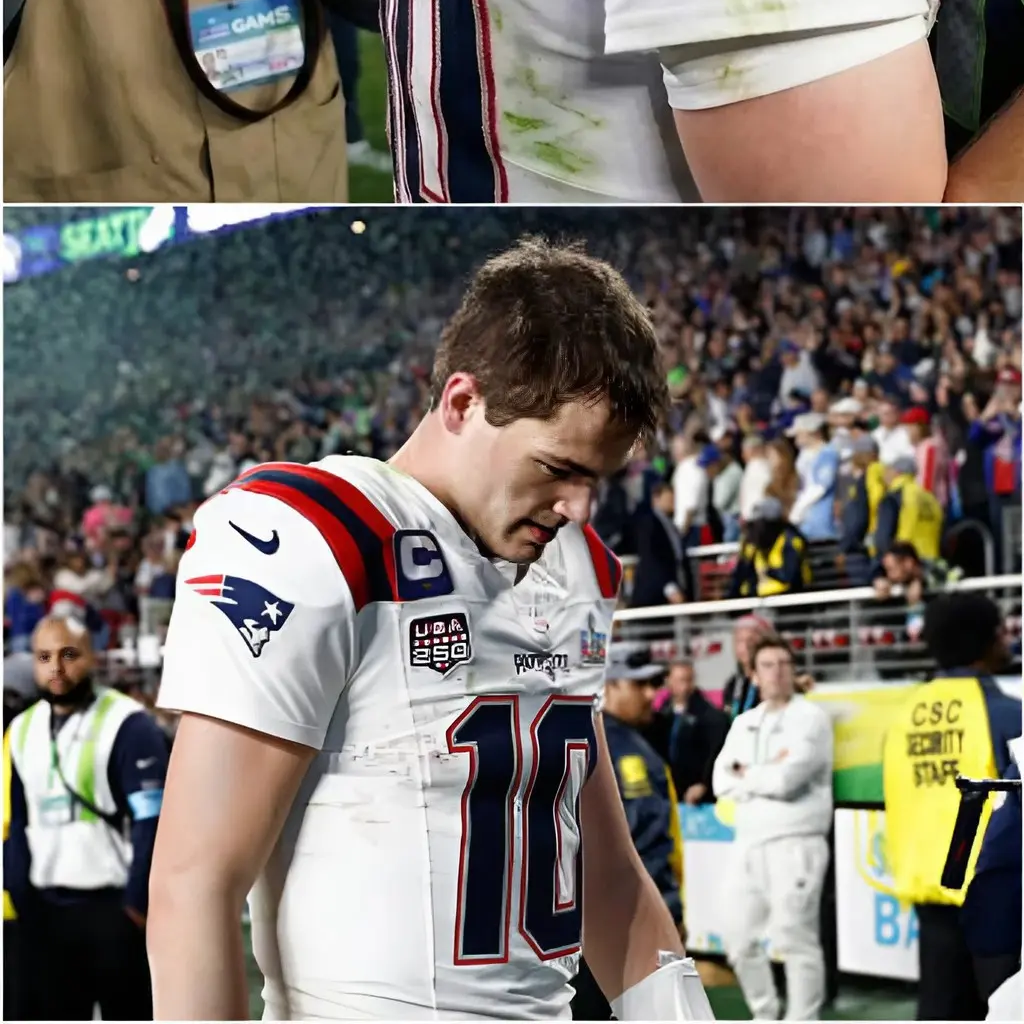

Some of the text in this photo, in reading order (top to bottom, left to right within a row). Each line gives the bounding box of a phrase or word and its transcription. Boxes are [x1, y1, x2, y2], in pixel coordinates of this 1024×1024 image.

[400, 535, 443, 581] C
[911, 699, 962, 727] CSC
[446, 694, 598, 966] 10
